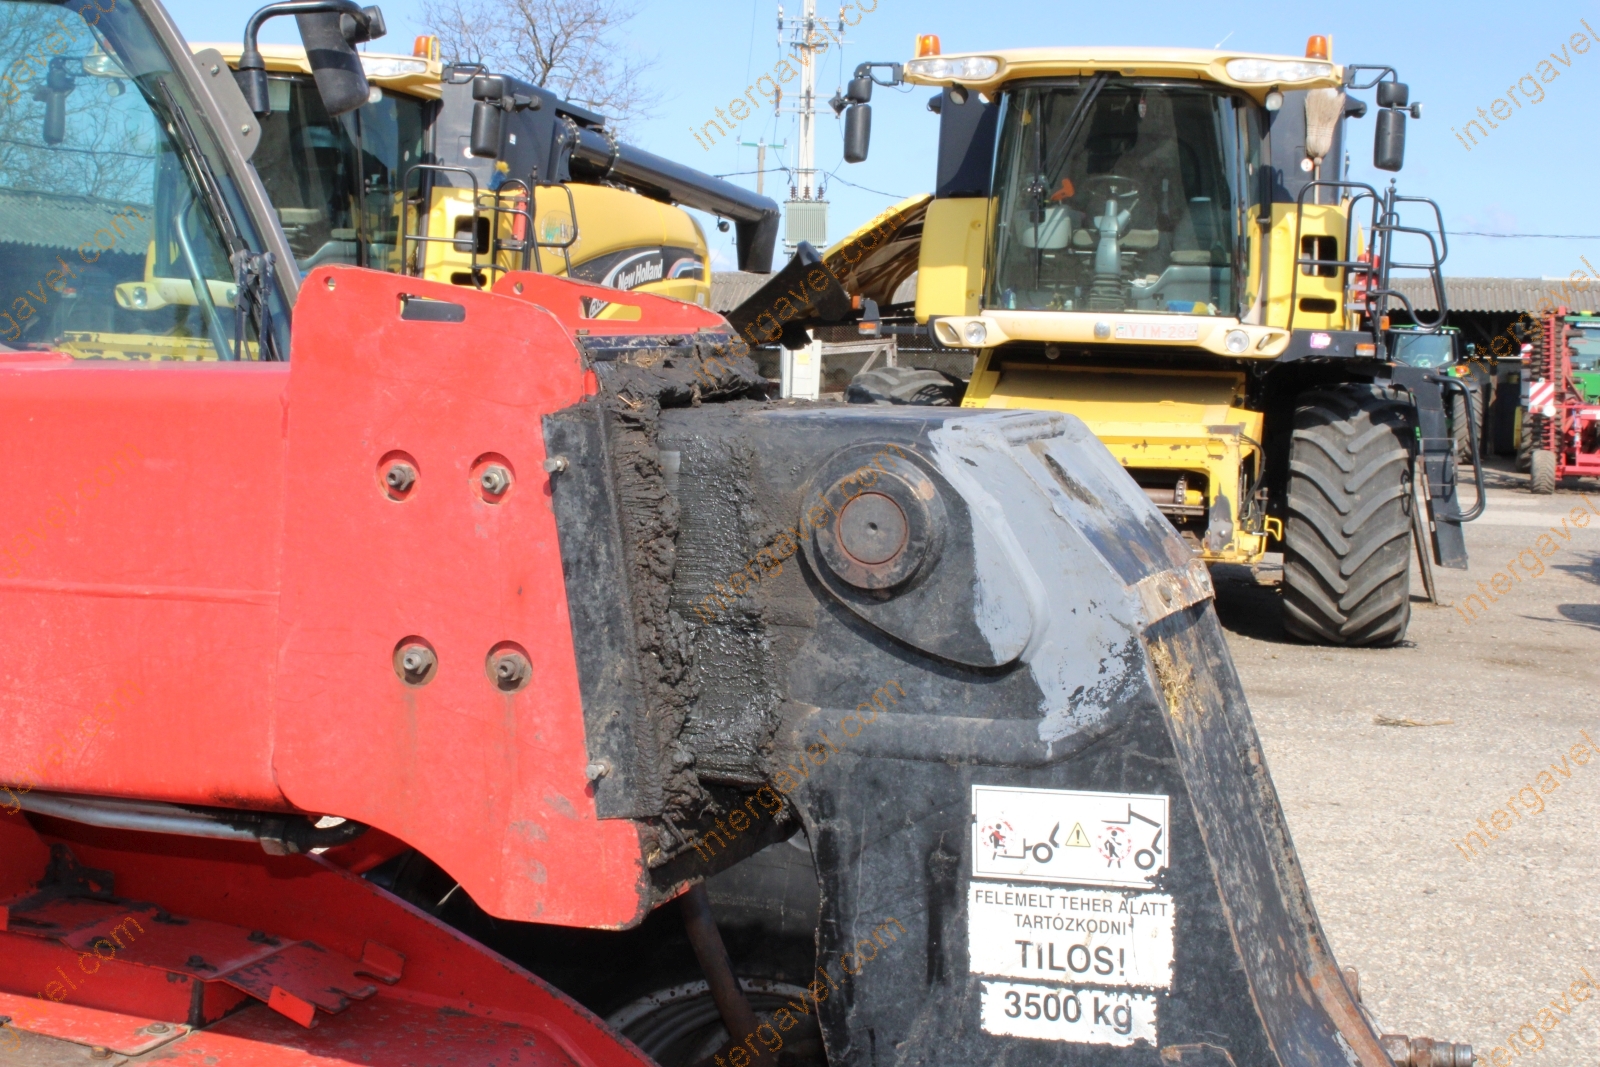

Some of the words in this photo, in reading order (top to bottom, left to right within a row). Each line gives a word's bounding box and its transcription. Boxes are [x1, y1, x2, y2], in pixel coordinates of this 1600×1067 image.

[618, 271, 636, 291] New
[635, 258, 664, 285] Holland
[975, 889, 1055, 909] FELEMELT
[1059, 895, 1113, 914] TEHER
[1117, 900, 1168, 917] ALATT
[1014, 913, 1127, 936] TARTÓZKODNI
[1014, 939, 1125, 977] TILOS!
[1004, 990, 1082, 1024] 3500
[1093, 996, 1133, 1036] kg
